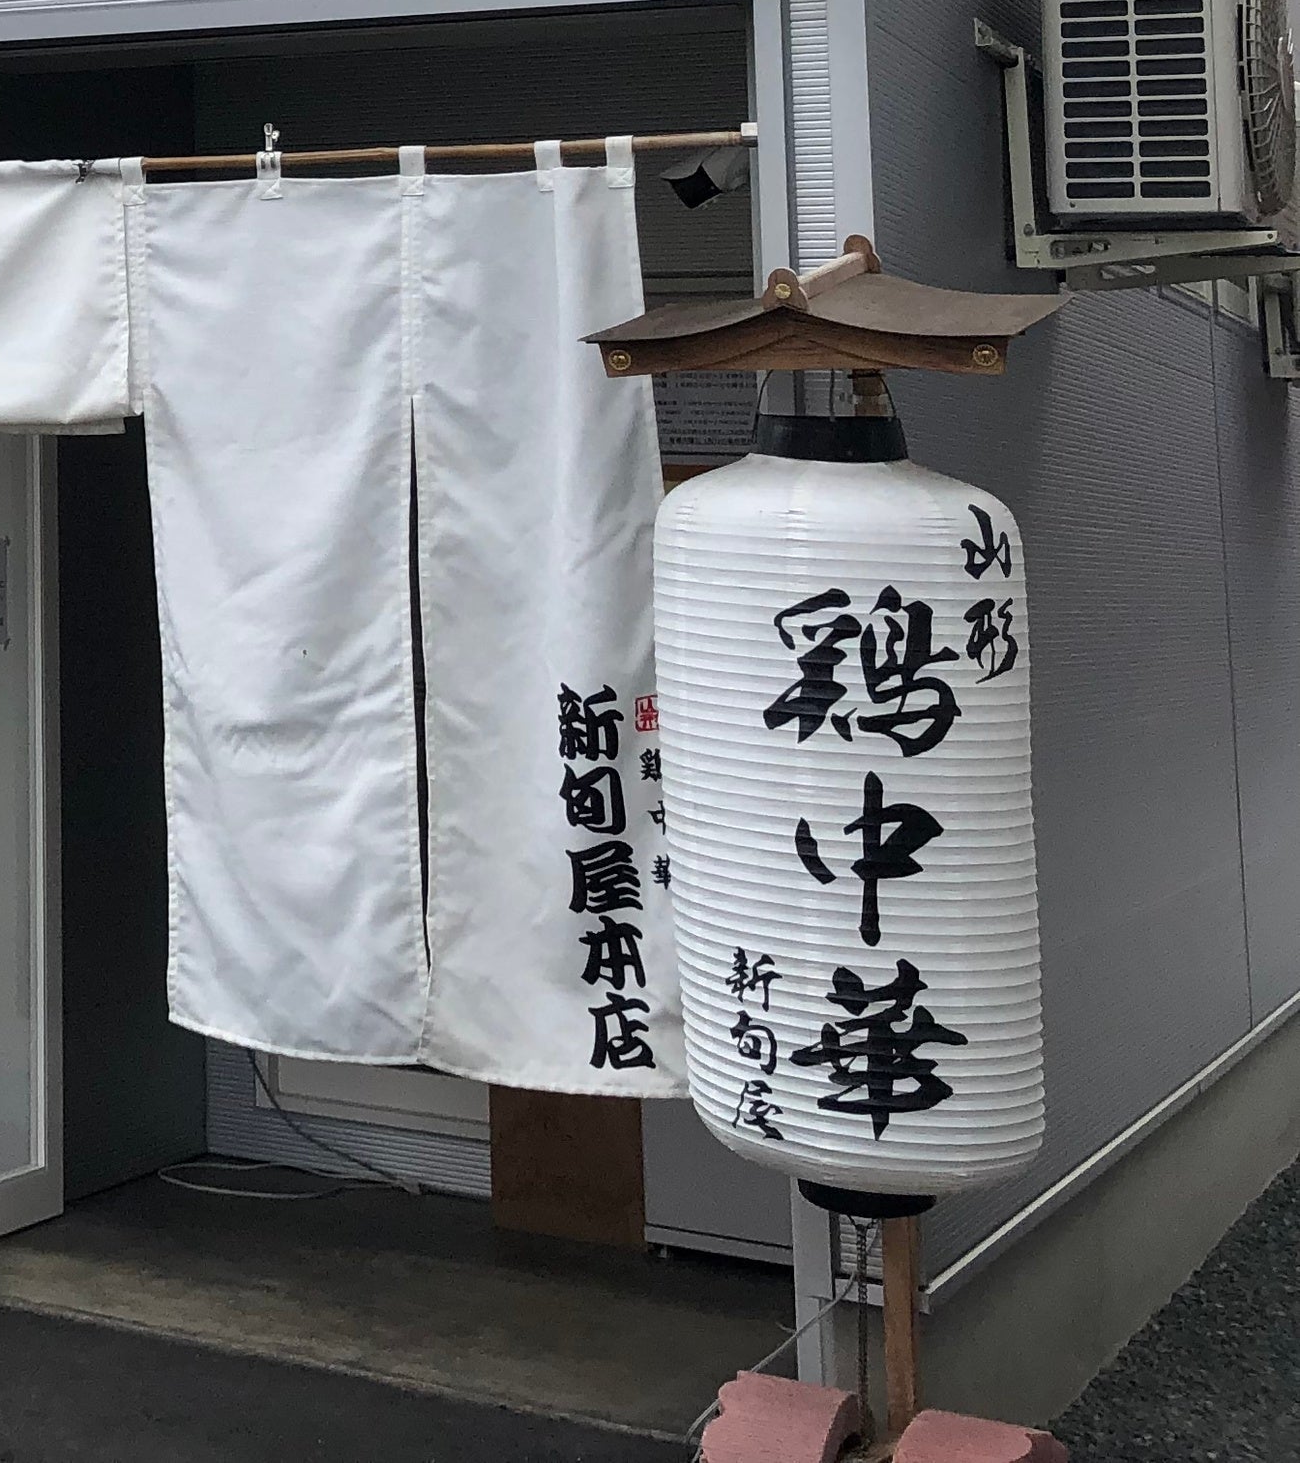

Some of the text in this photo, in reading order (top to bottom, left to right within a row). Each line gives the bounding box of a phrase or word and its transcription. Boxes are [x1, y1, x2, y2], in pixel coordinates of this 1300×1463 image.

[961, 504, 1020, 683] 山形
[557, 682, 657, 1069] 新旬屋本店
[762, 585, 968, 1141] 鶏中華
[725, 947, 786, 1142] 新旬屋
